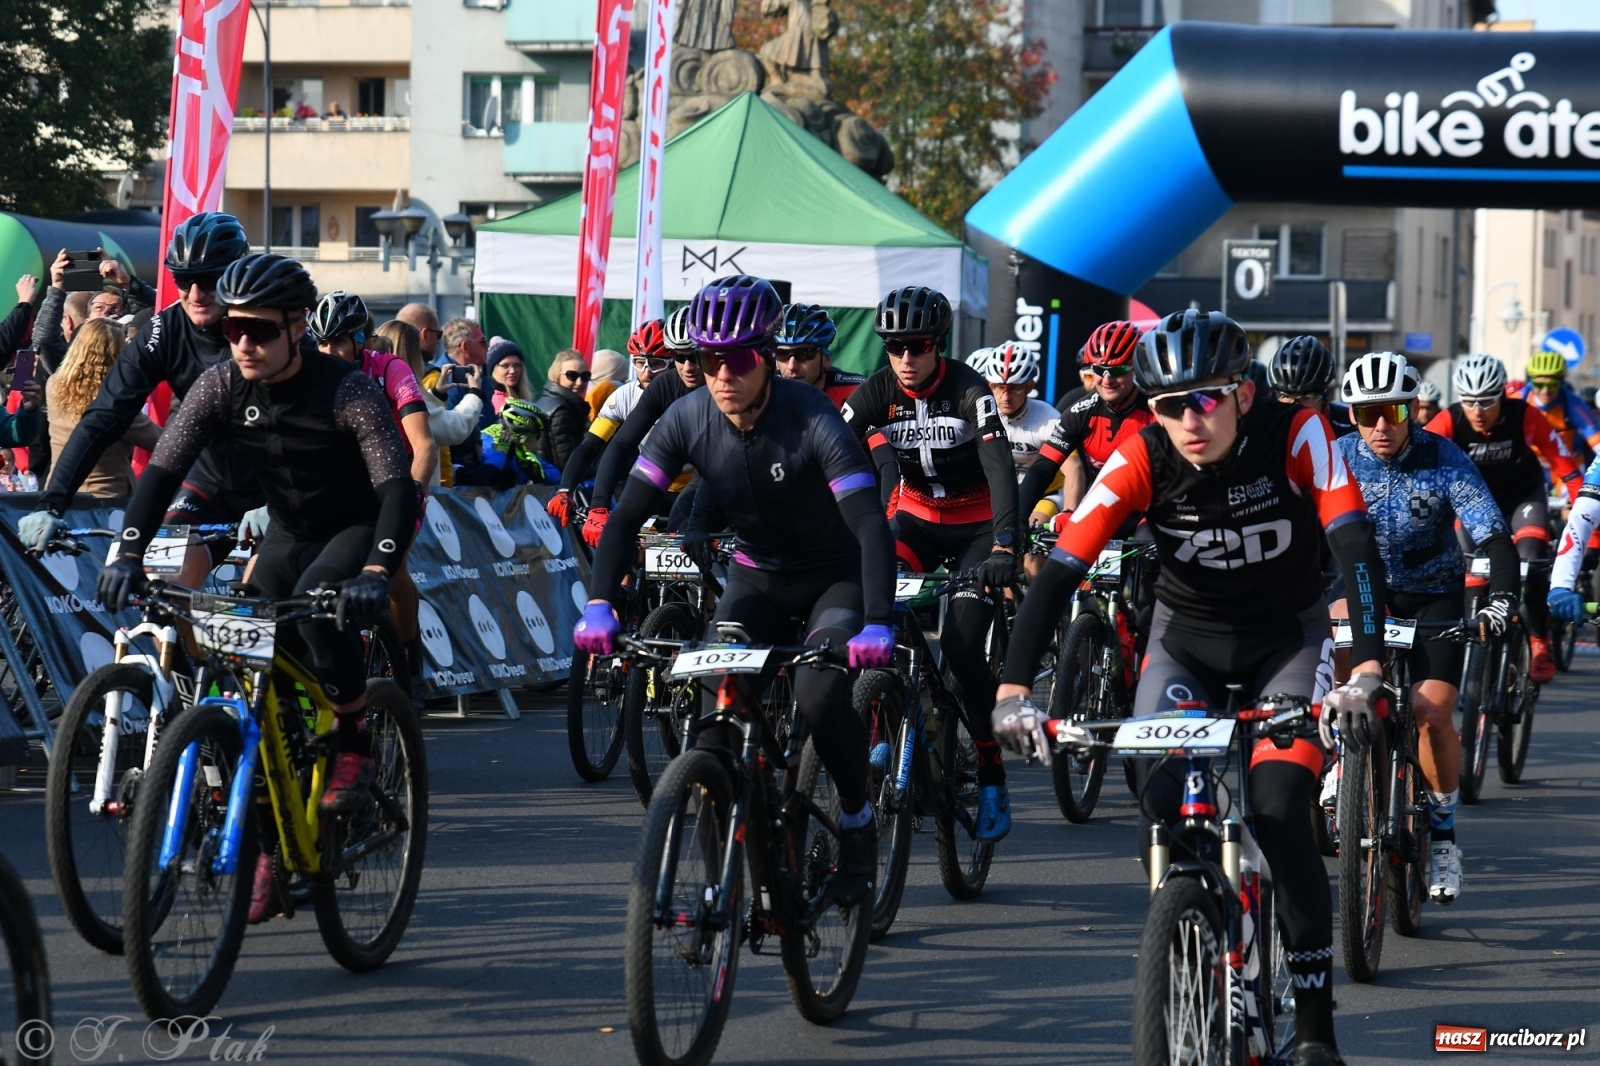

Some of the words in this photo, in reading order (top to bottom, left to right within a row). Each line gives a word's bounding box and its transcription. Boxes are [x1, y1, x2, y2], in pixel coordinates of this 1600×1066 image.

[1340, 90, 1484, 158] bike
[1231, 247, 1270, 258] SEKTOR
[1235, 258, 1265, 300] 0
[492, 561, 530, 577] KOKOwear
[656, 554, 693, 569] 1500
[441, 563, 480, 580] KOKOwear
[692, 652, 754, 667] 1037
[432, 669, 476, 688] KOKOwear
[489, 662, 526, 679] KOKOwear
[1135, 724, 1210, 740] 3066
